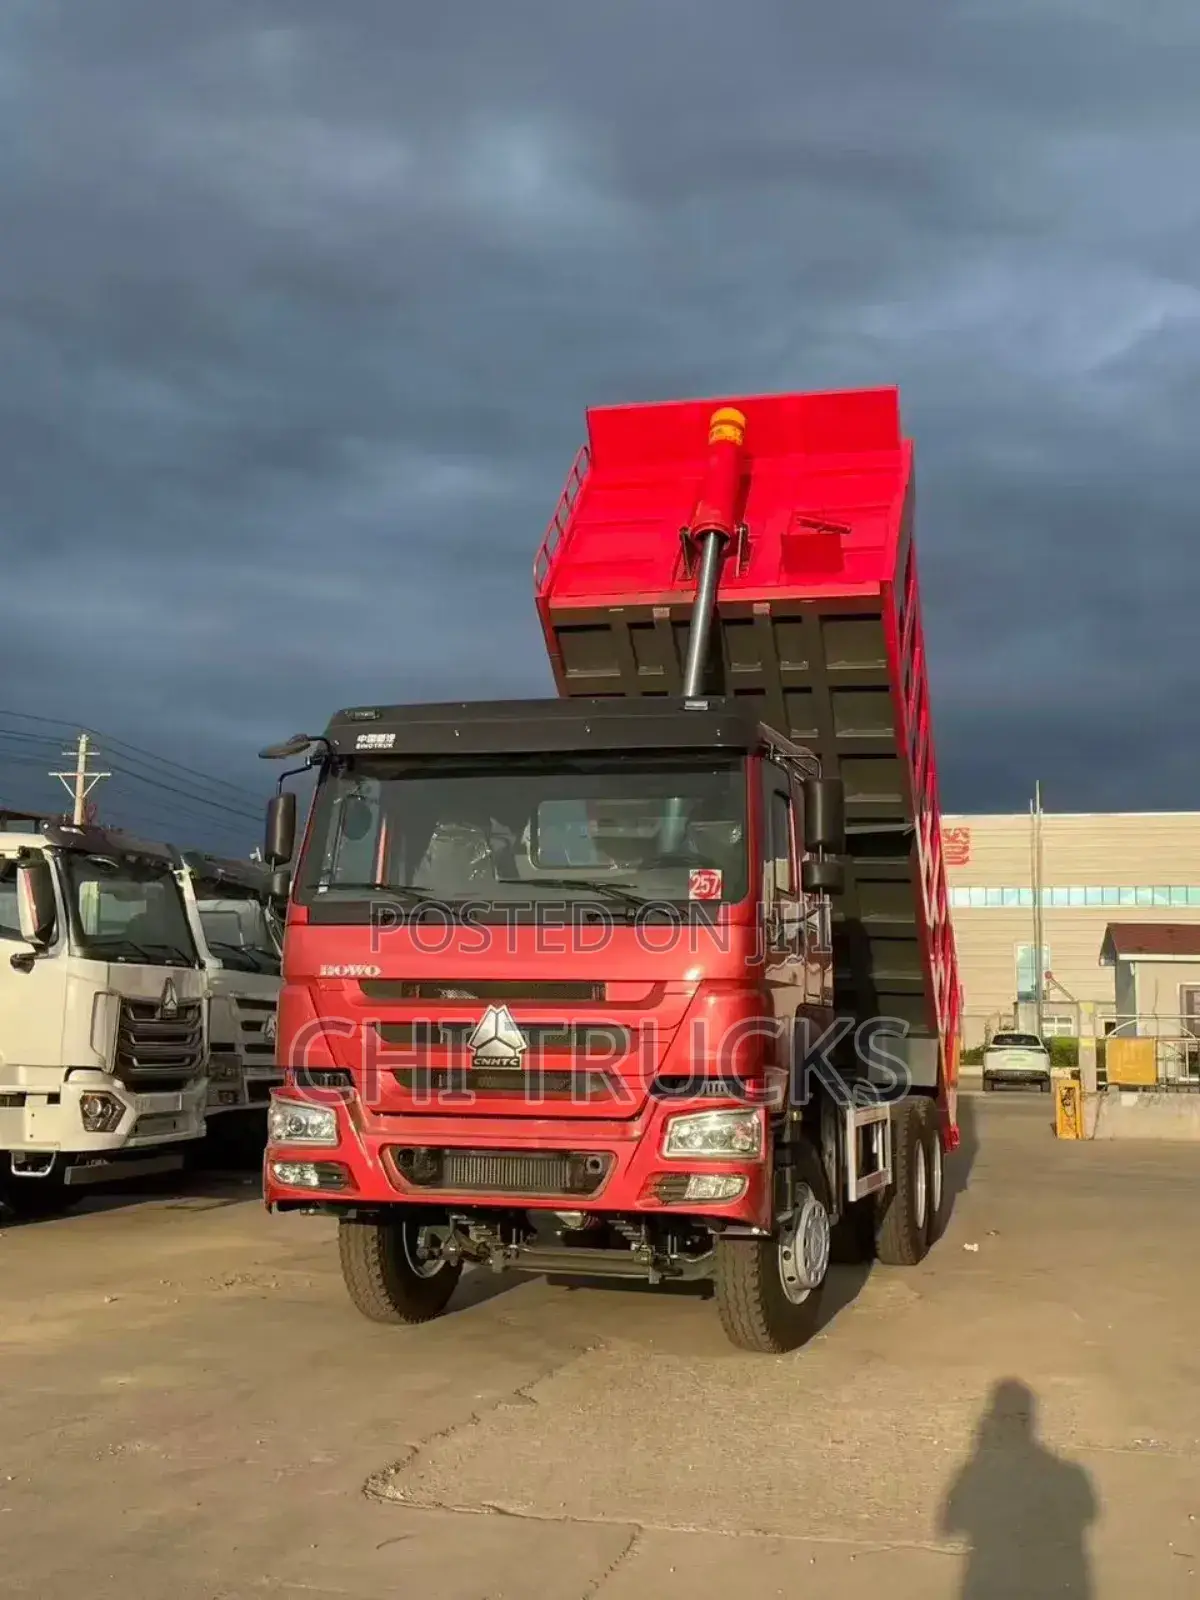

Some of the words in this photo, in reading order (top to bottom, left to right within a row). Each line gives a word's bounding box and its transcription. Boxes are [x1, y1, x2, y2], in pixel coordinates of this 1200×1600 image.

[691, 873, 719, 894] 257
[319, 964, 381, 977] HOWO
[473, 1058, 519, 1066] CNHTC
